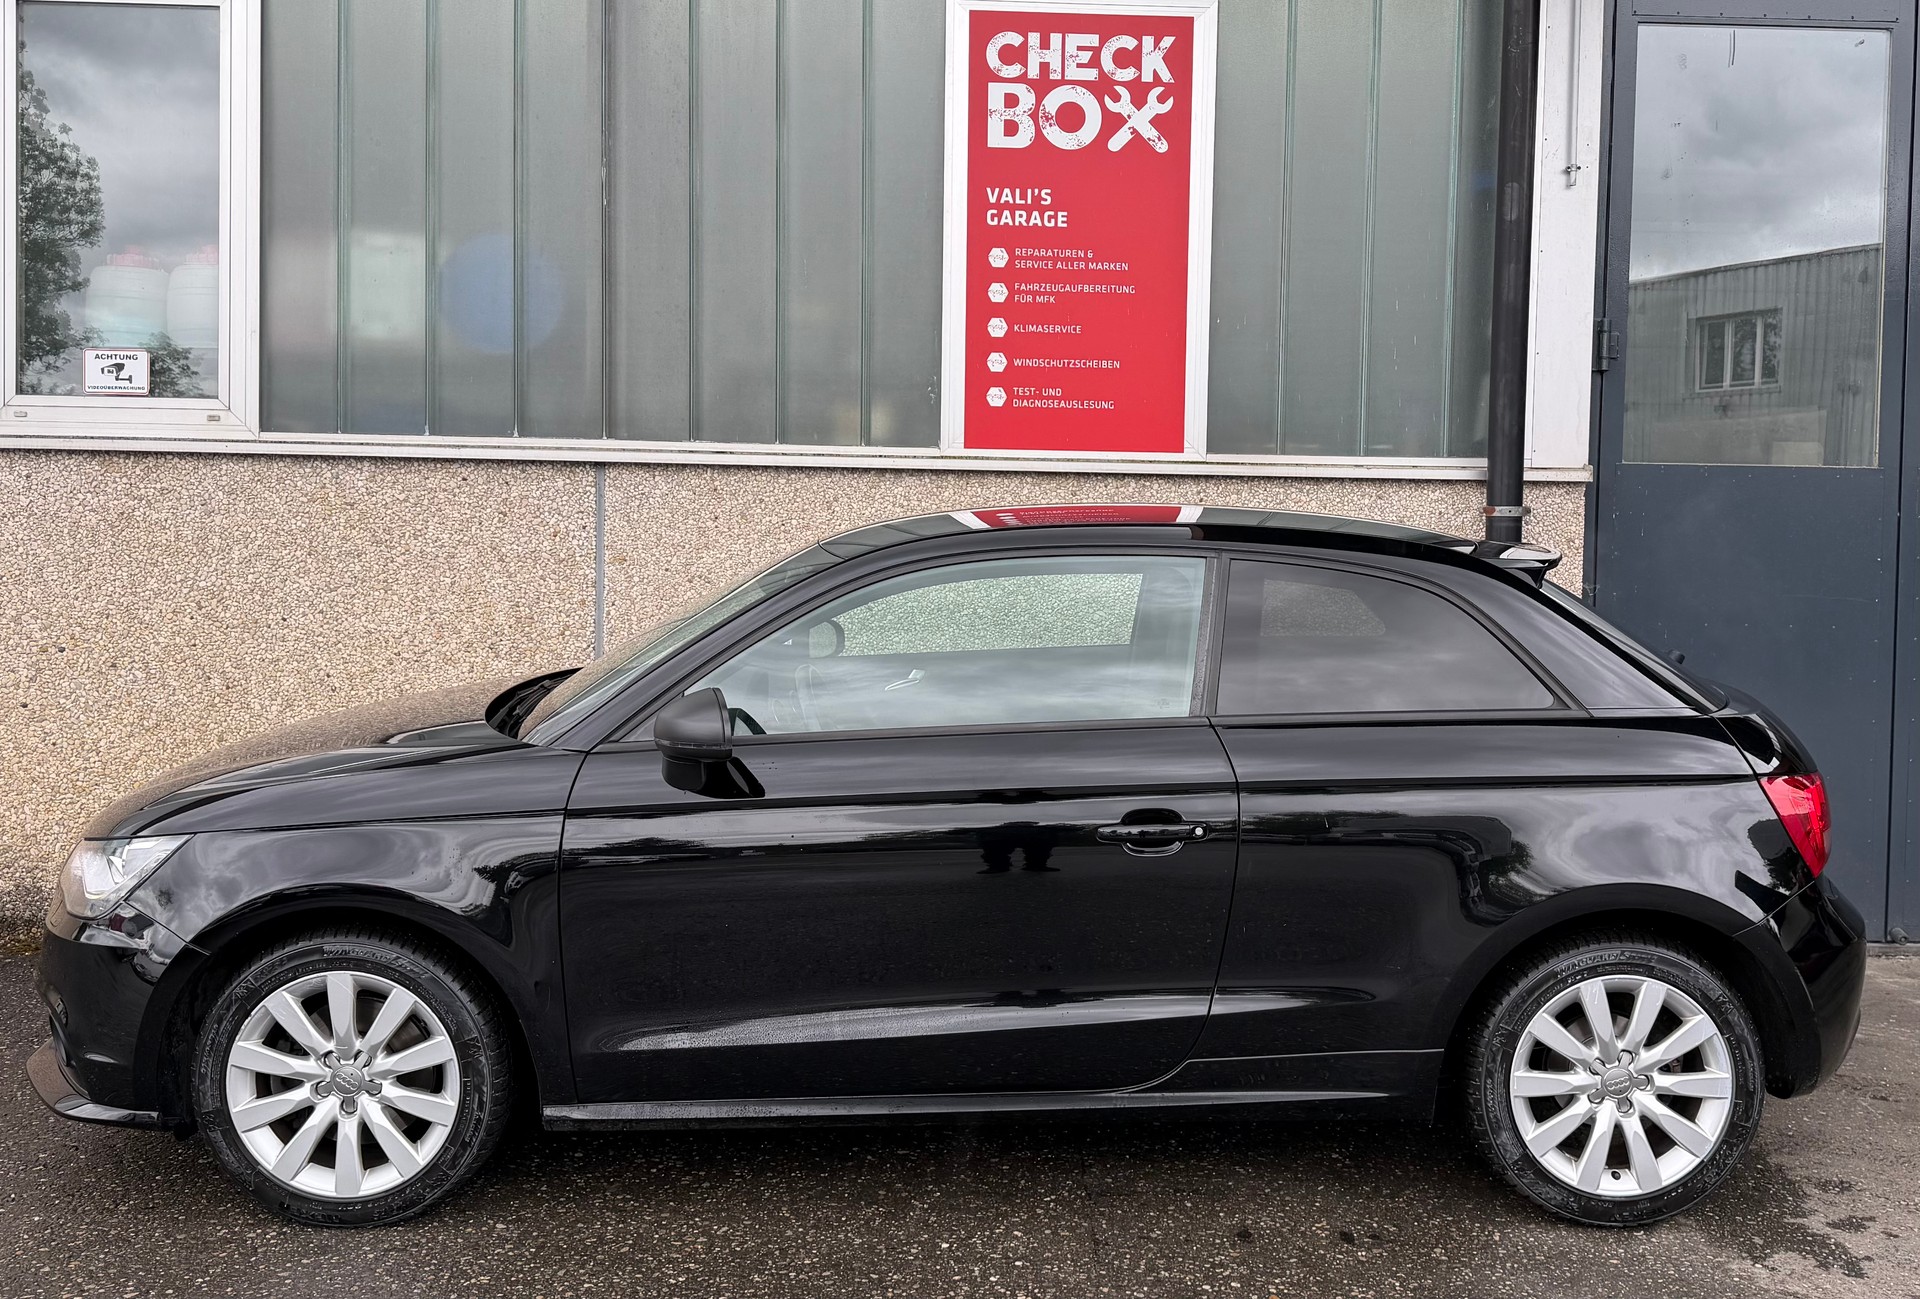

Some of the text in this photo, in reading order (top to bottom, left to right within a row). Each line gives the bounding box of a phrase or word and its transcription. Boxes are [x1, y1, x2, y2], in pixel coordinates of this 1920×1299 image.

[986, 31, 1176, 83] CHECK
[987, 82, 1174, 153] BOX
[986, 188, 1052, 205] VALI'S
[986, 210, 1068, 227] GARAGE
[1015, 248, 1093, 258] REPARATUREN &
[1015, 261, 1128, 271] SERVICE ALLER MARKEN
[1014, 283, 1135, 293] FAHRZEUGAUFBEREITUNG
[1014, 294, 1056, 303] FÜR MFK
[1014, 324, 1082, 334] KLIMASERVICE
[1013, 358, 1120, 369] WINDSCHUTZSCHEIBEN
[1013, 387, 1062, 396] TEST- UND
[1012, 399, 1114, 409] DIAGNOSEAUSLESUNG
